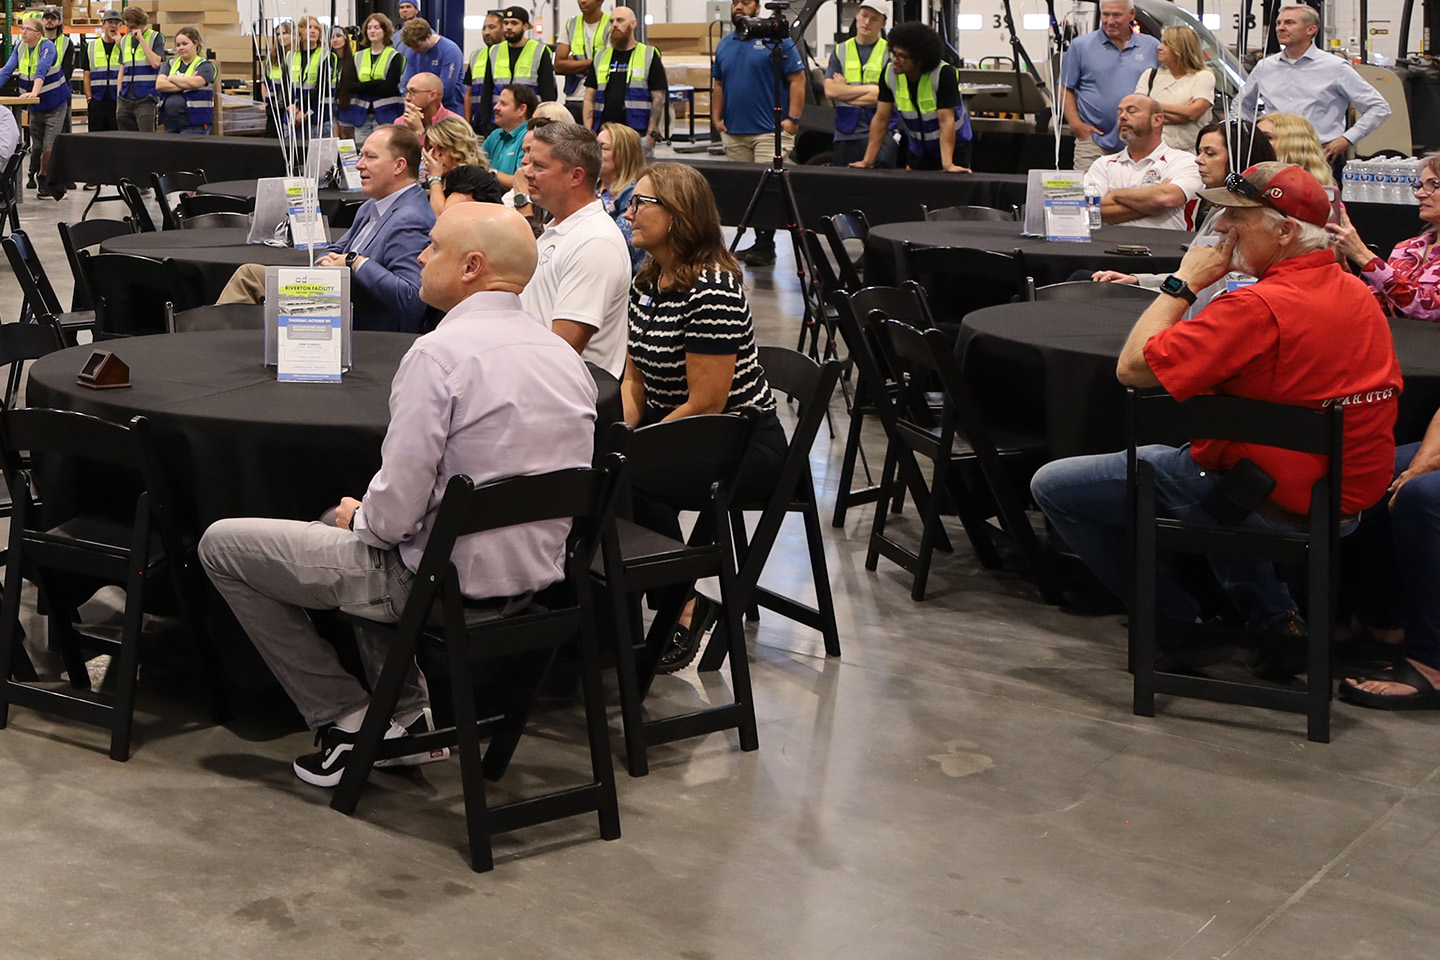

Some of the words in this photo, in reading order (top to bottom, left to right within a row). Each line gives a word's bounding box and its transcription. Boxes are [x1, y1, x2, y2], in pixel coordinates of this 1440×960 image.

[1272, 189, 1282, 197] U
[1321, 394, 1362, 408] UTAH
[1366, 388, 1393, 402] UTES
